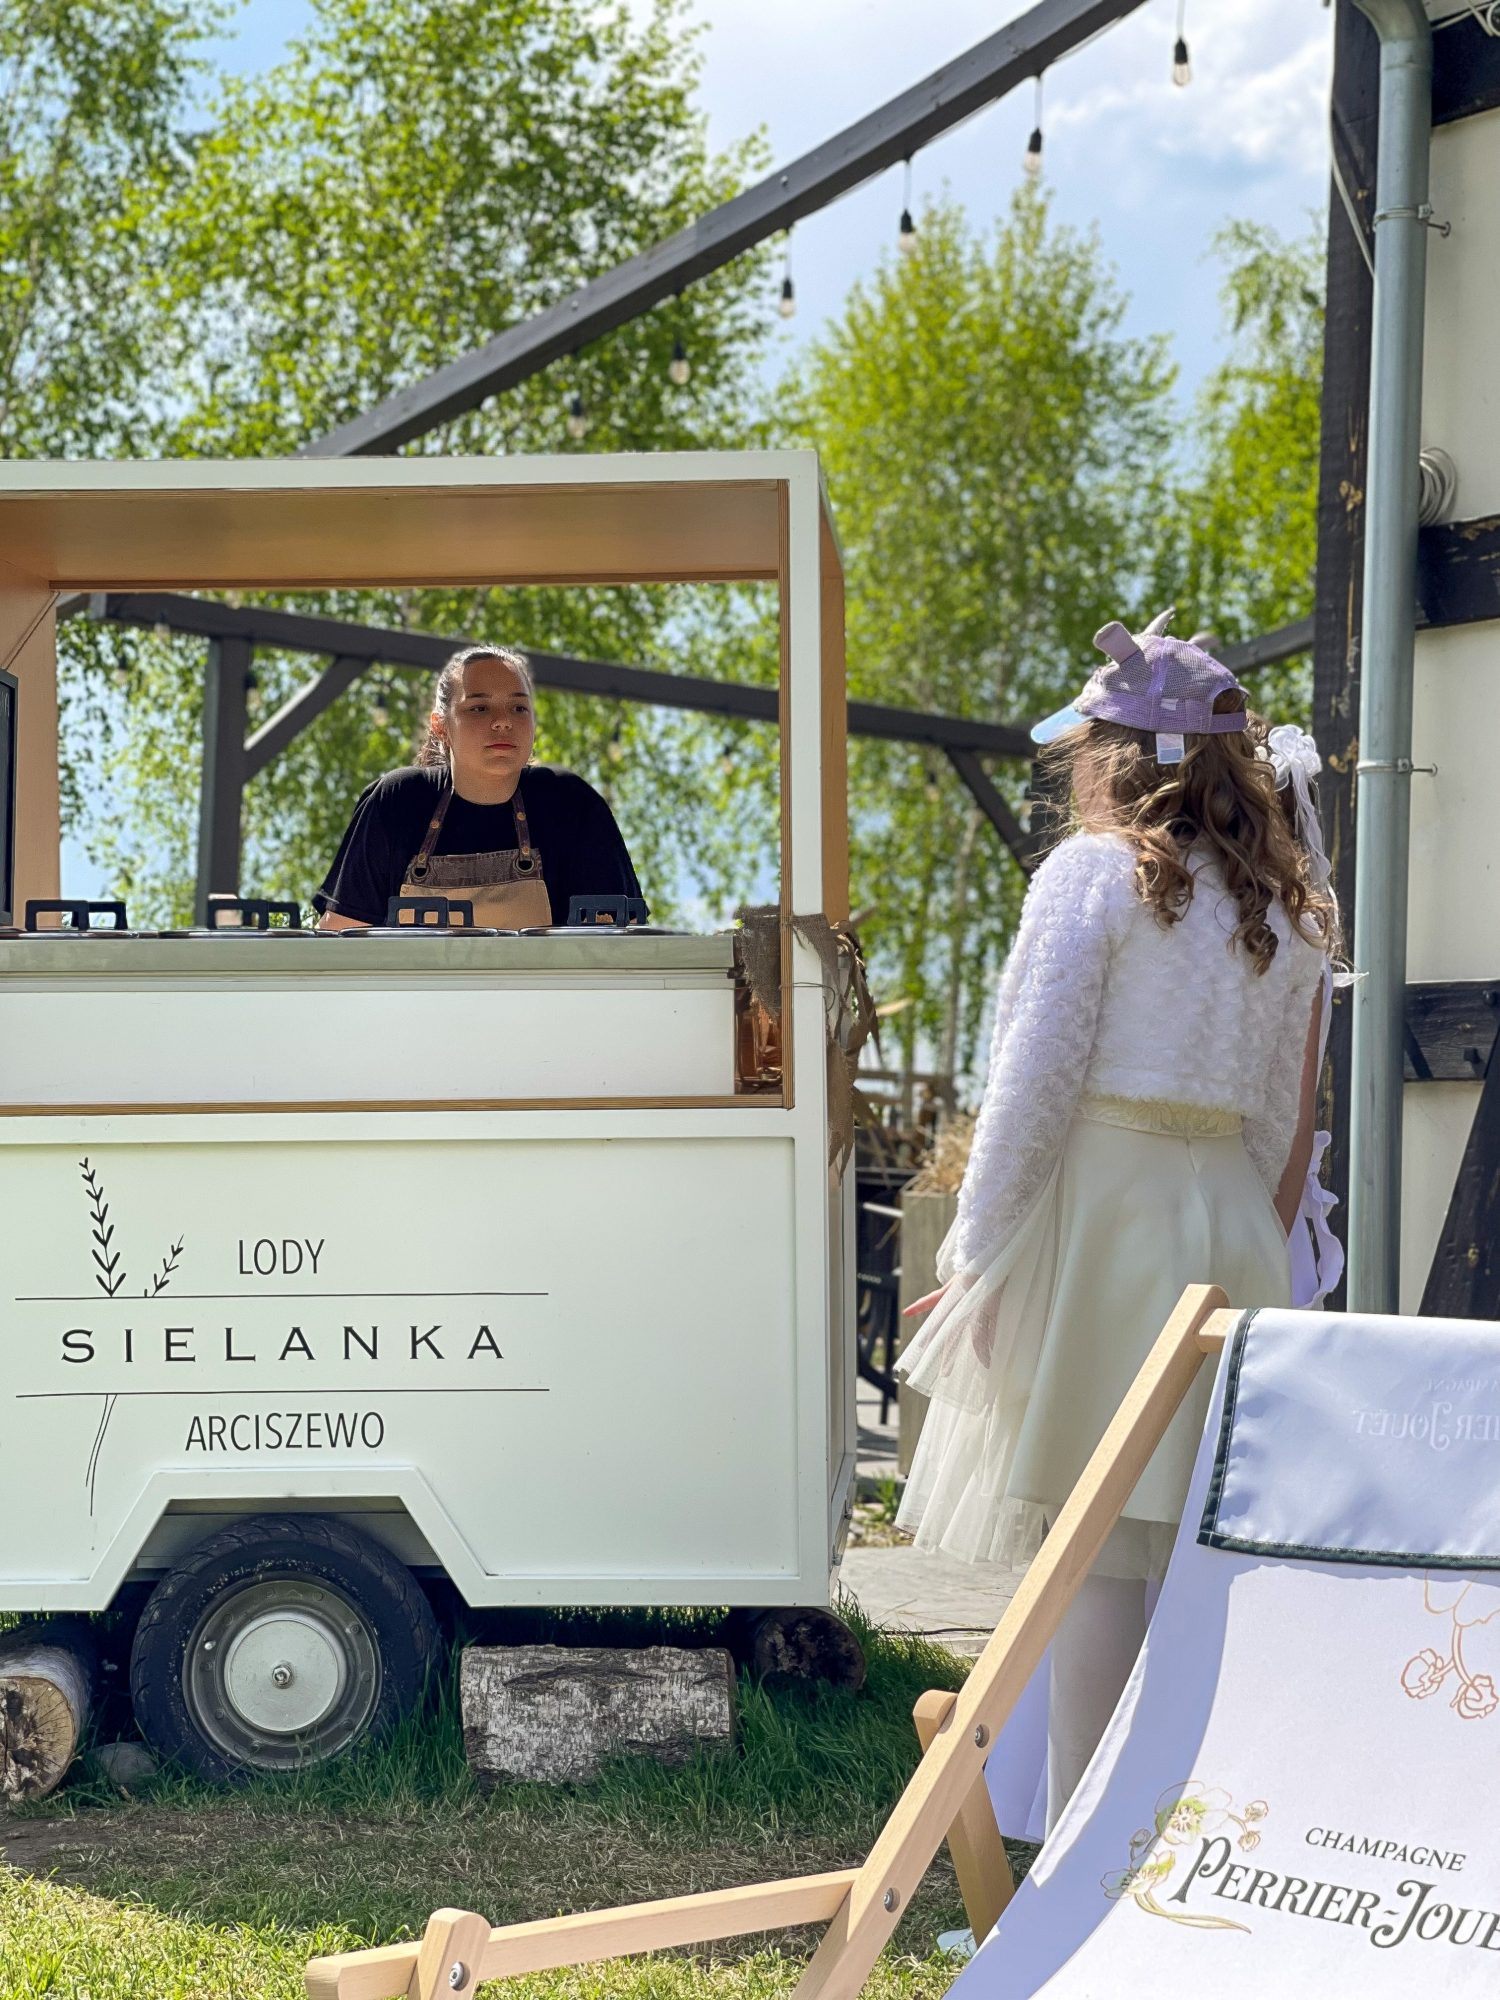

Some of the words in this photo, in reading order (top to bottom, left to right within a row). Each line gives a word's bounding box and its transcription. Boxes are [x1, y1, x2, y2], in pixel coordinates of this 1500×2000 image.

[239, 1239, 325, 1275] LODY
[61, 1326, 504, 1363] SIELANKA
[186, 1412, 385, 1451] ARCISZEWO
[1305, 1827, 1467, 1872] CHAMPAGNE
